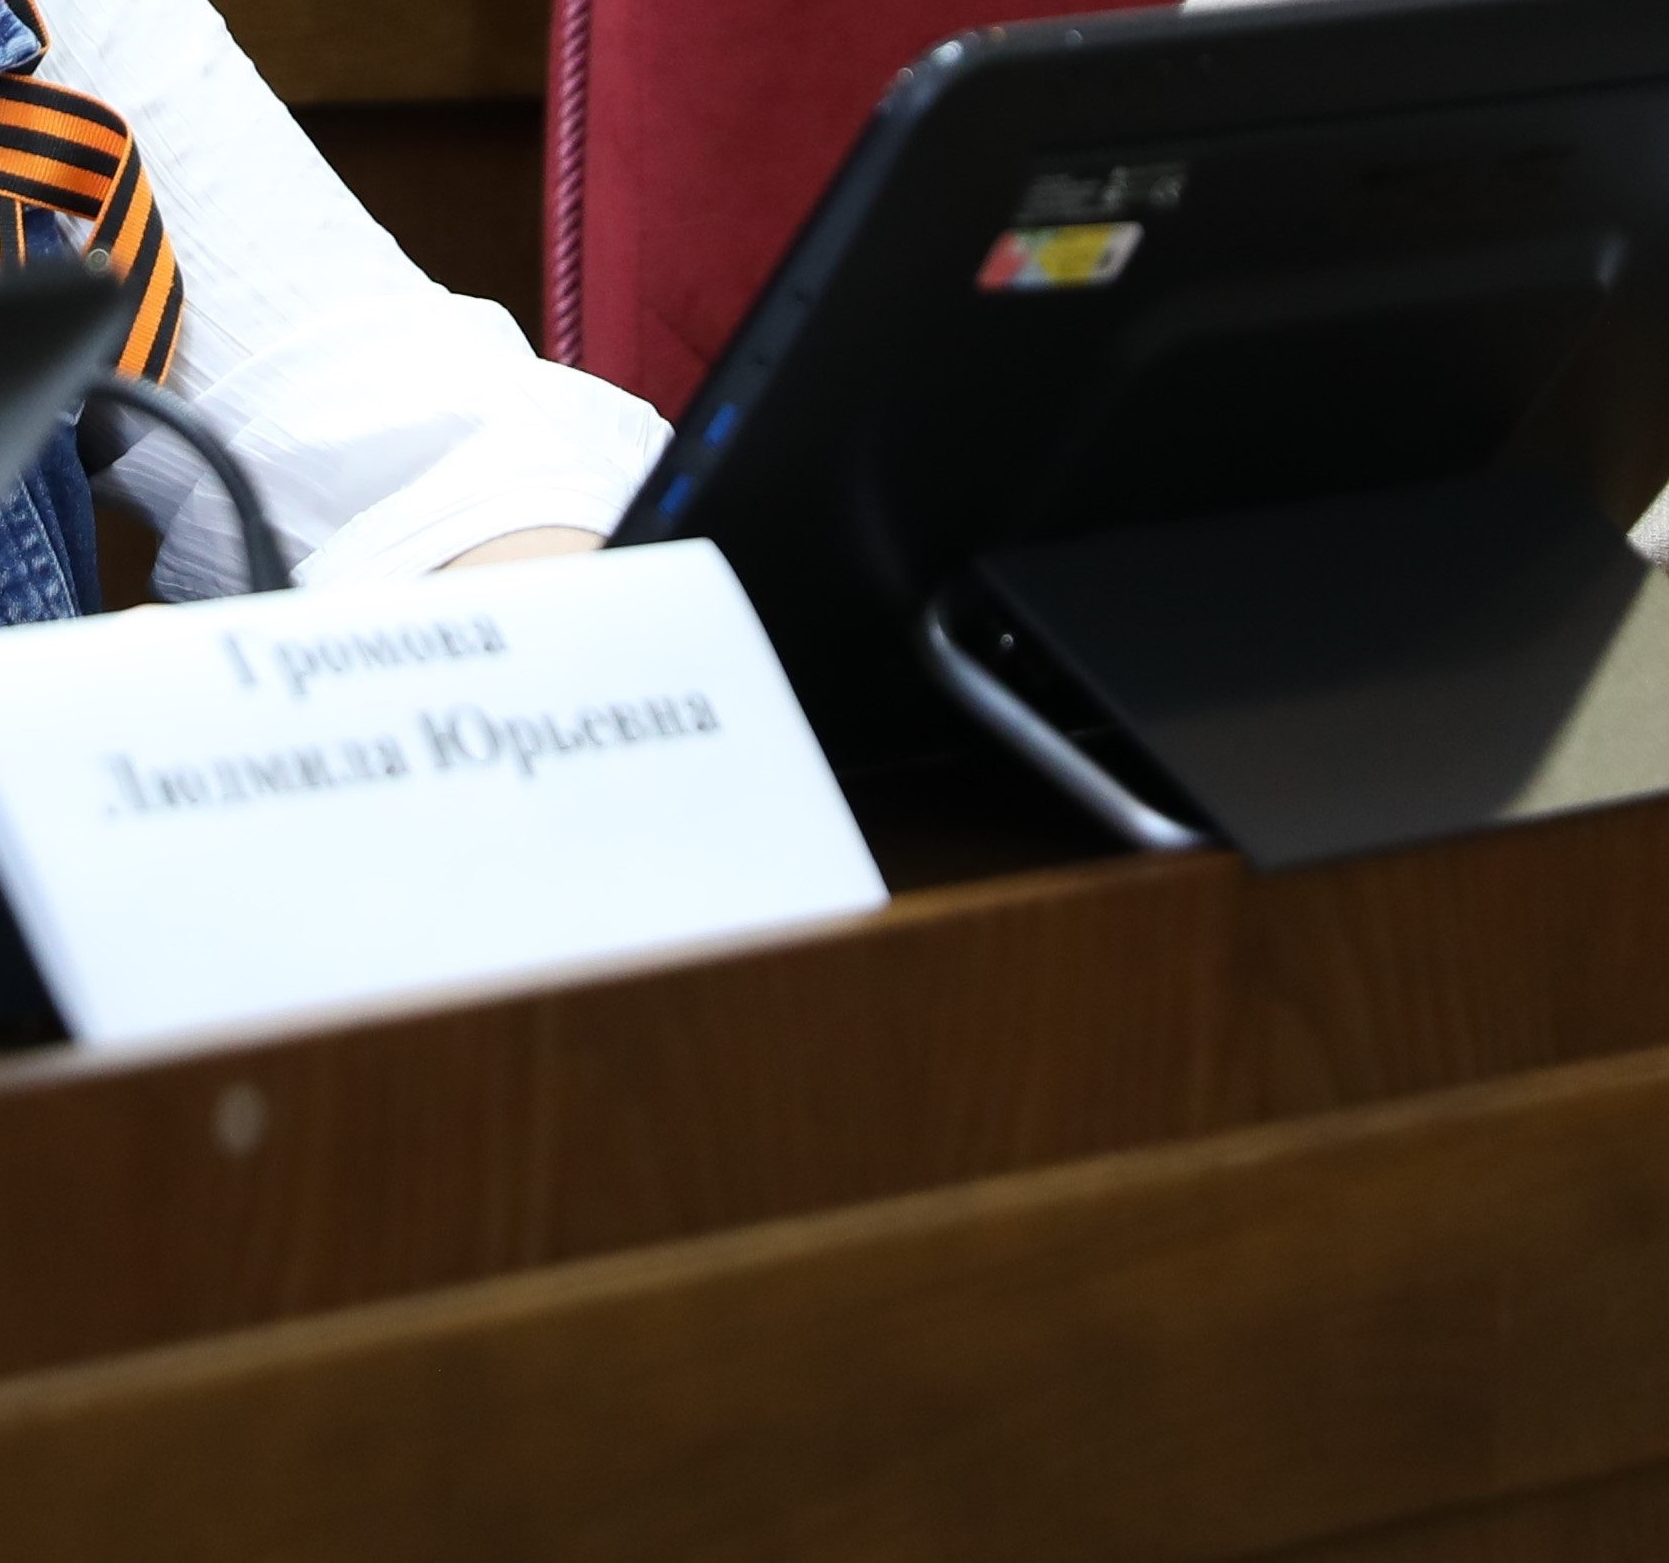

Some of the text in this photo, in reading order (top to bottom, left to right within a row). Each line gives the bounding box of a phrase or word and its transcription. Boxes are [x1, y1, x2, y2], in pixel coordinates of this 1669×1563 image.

[221, 613, 509, 699] Громова
[104, 691, 722, 815] Людмила Юрьевна
